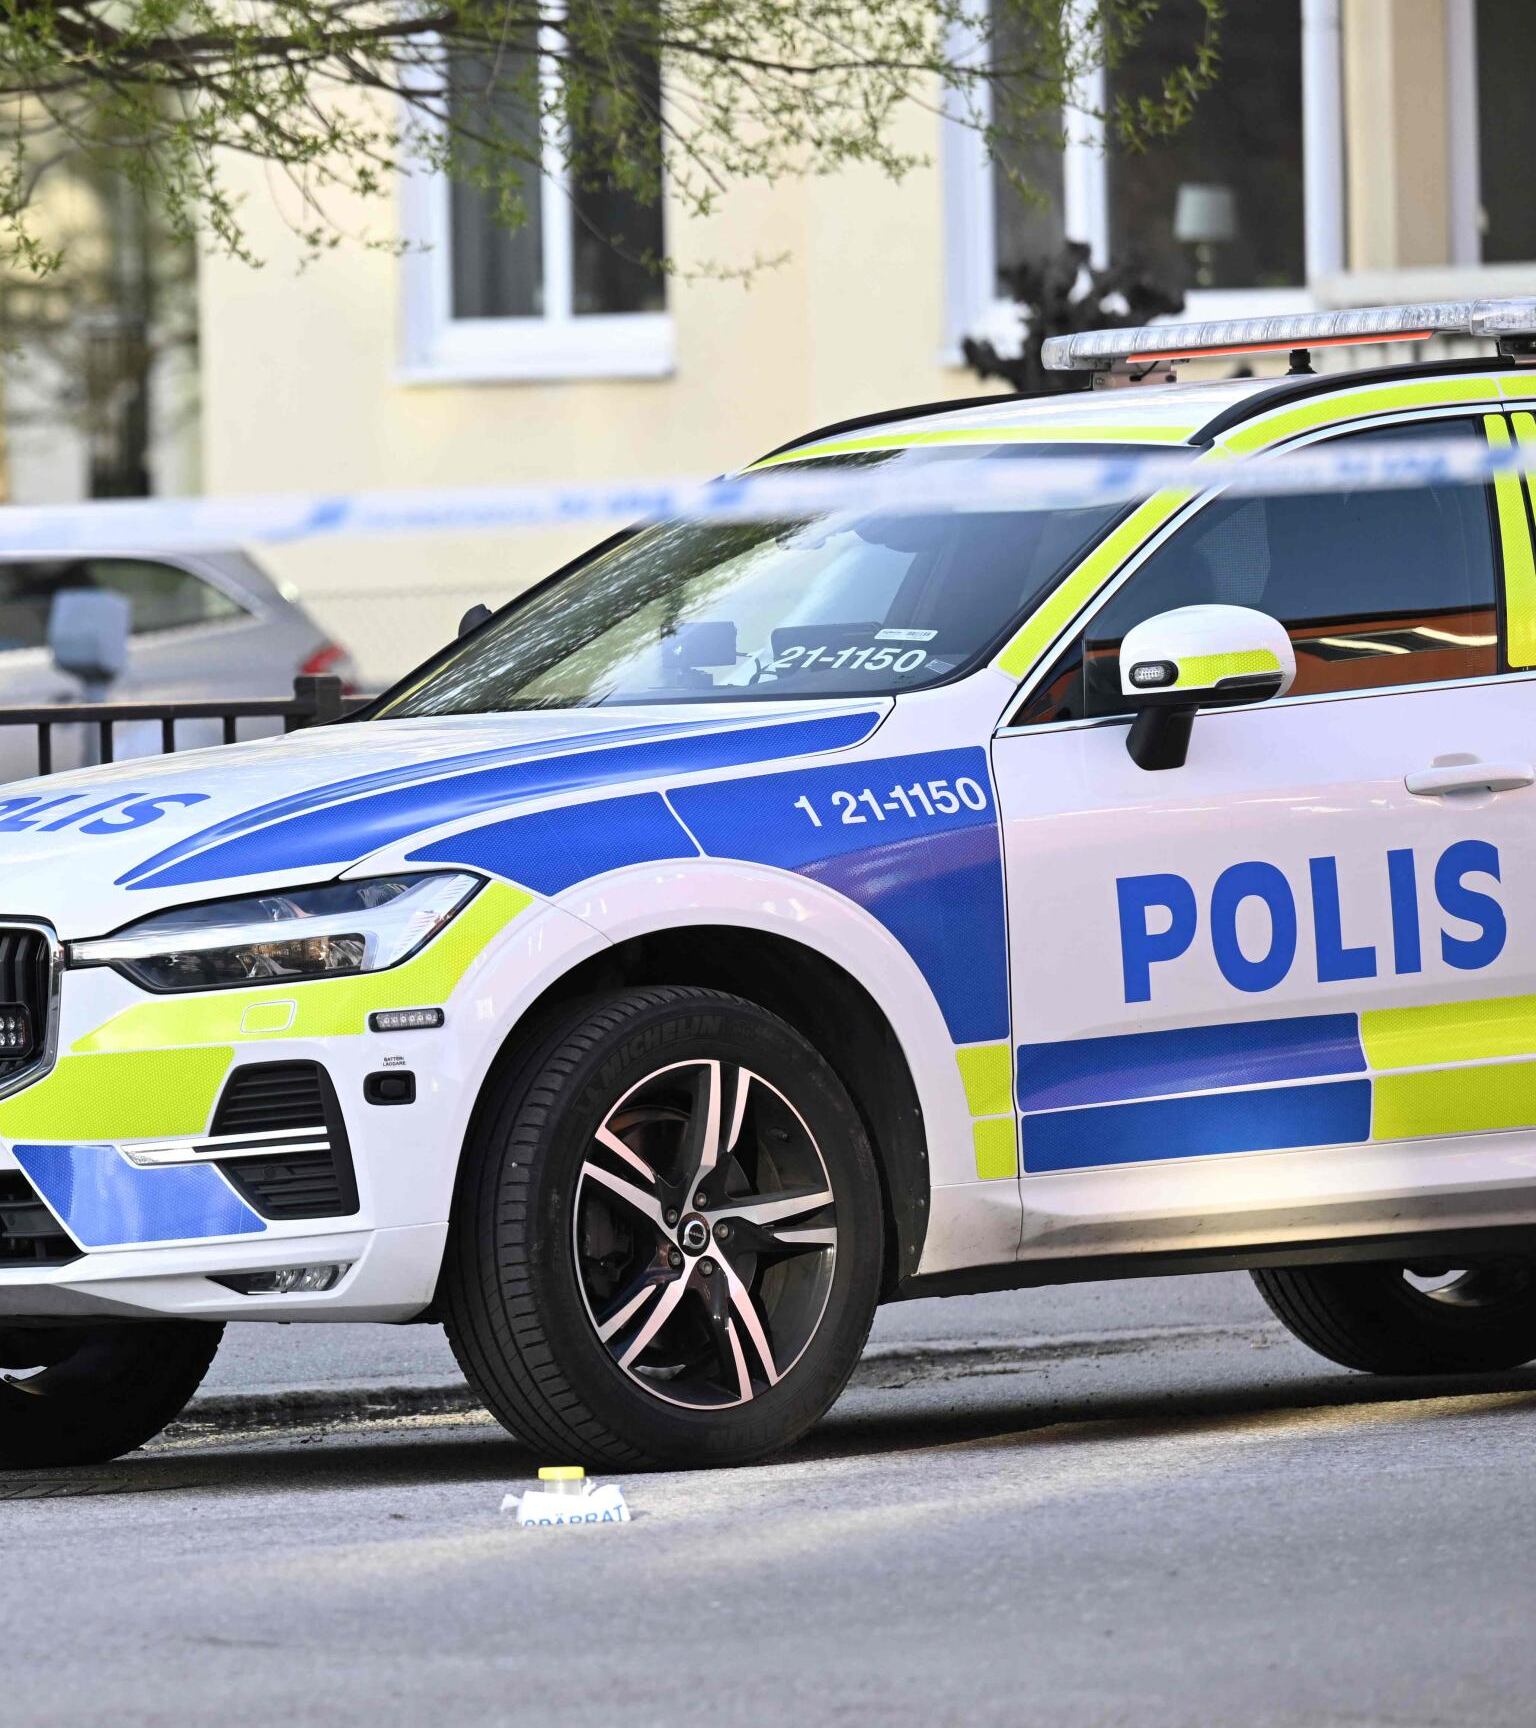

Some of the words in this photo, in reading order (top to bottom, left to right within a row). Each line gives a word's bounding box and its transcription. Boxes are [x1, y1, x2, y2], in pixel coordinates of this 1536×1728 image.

[769, 646, 928, 674] 21-1150
[793, 795, 824, 827] 1
[830, 777, 988, 825] 21-1150
[1116, 839, 1508, 1004] POLIS
[600, 1014, 723, 1086] MICHELIN
